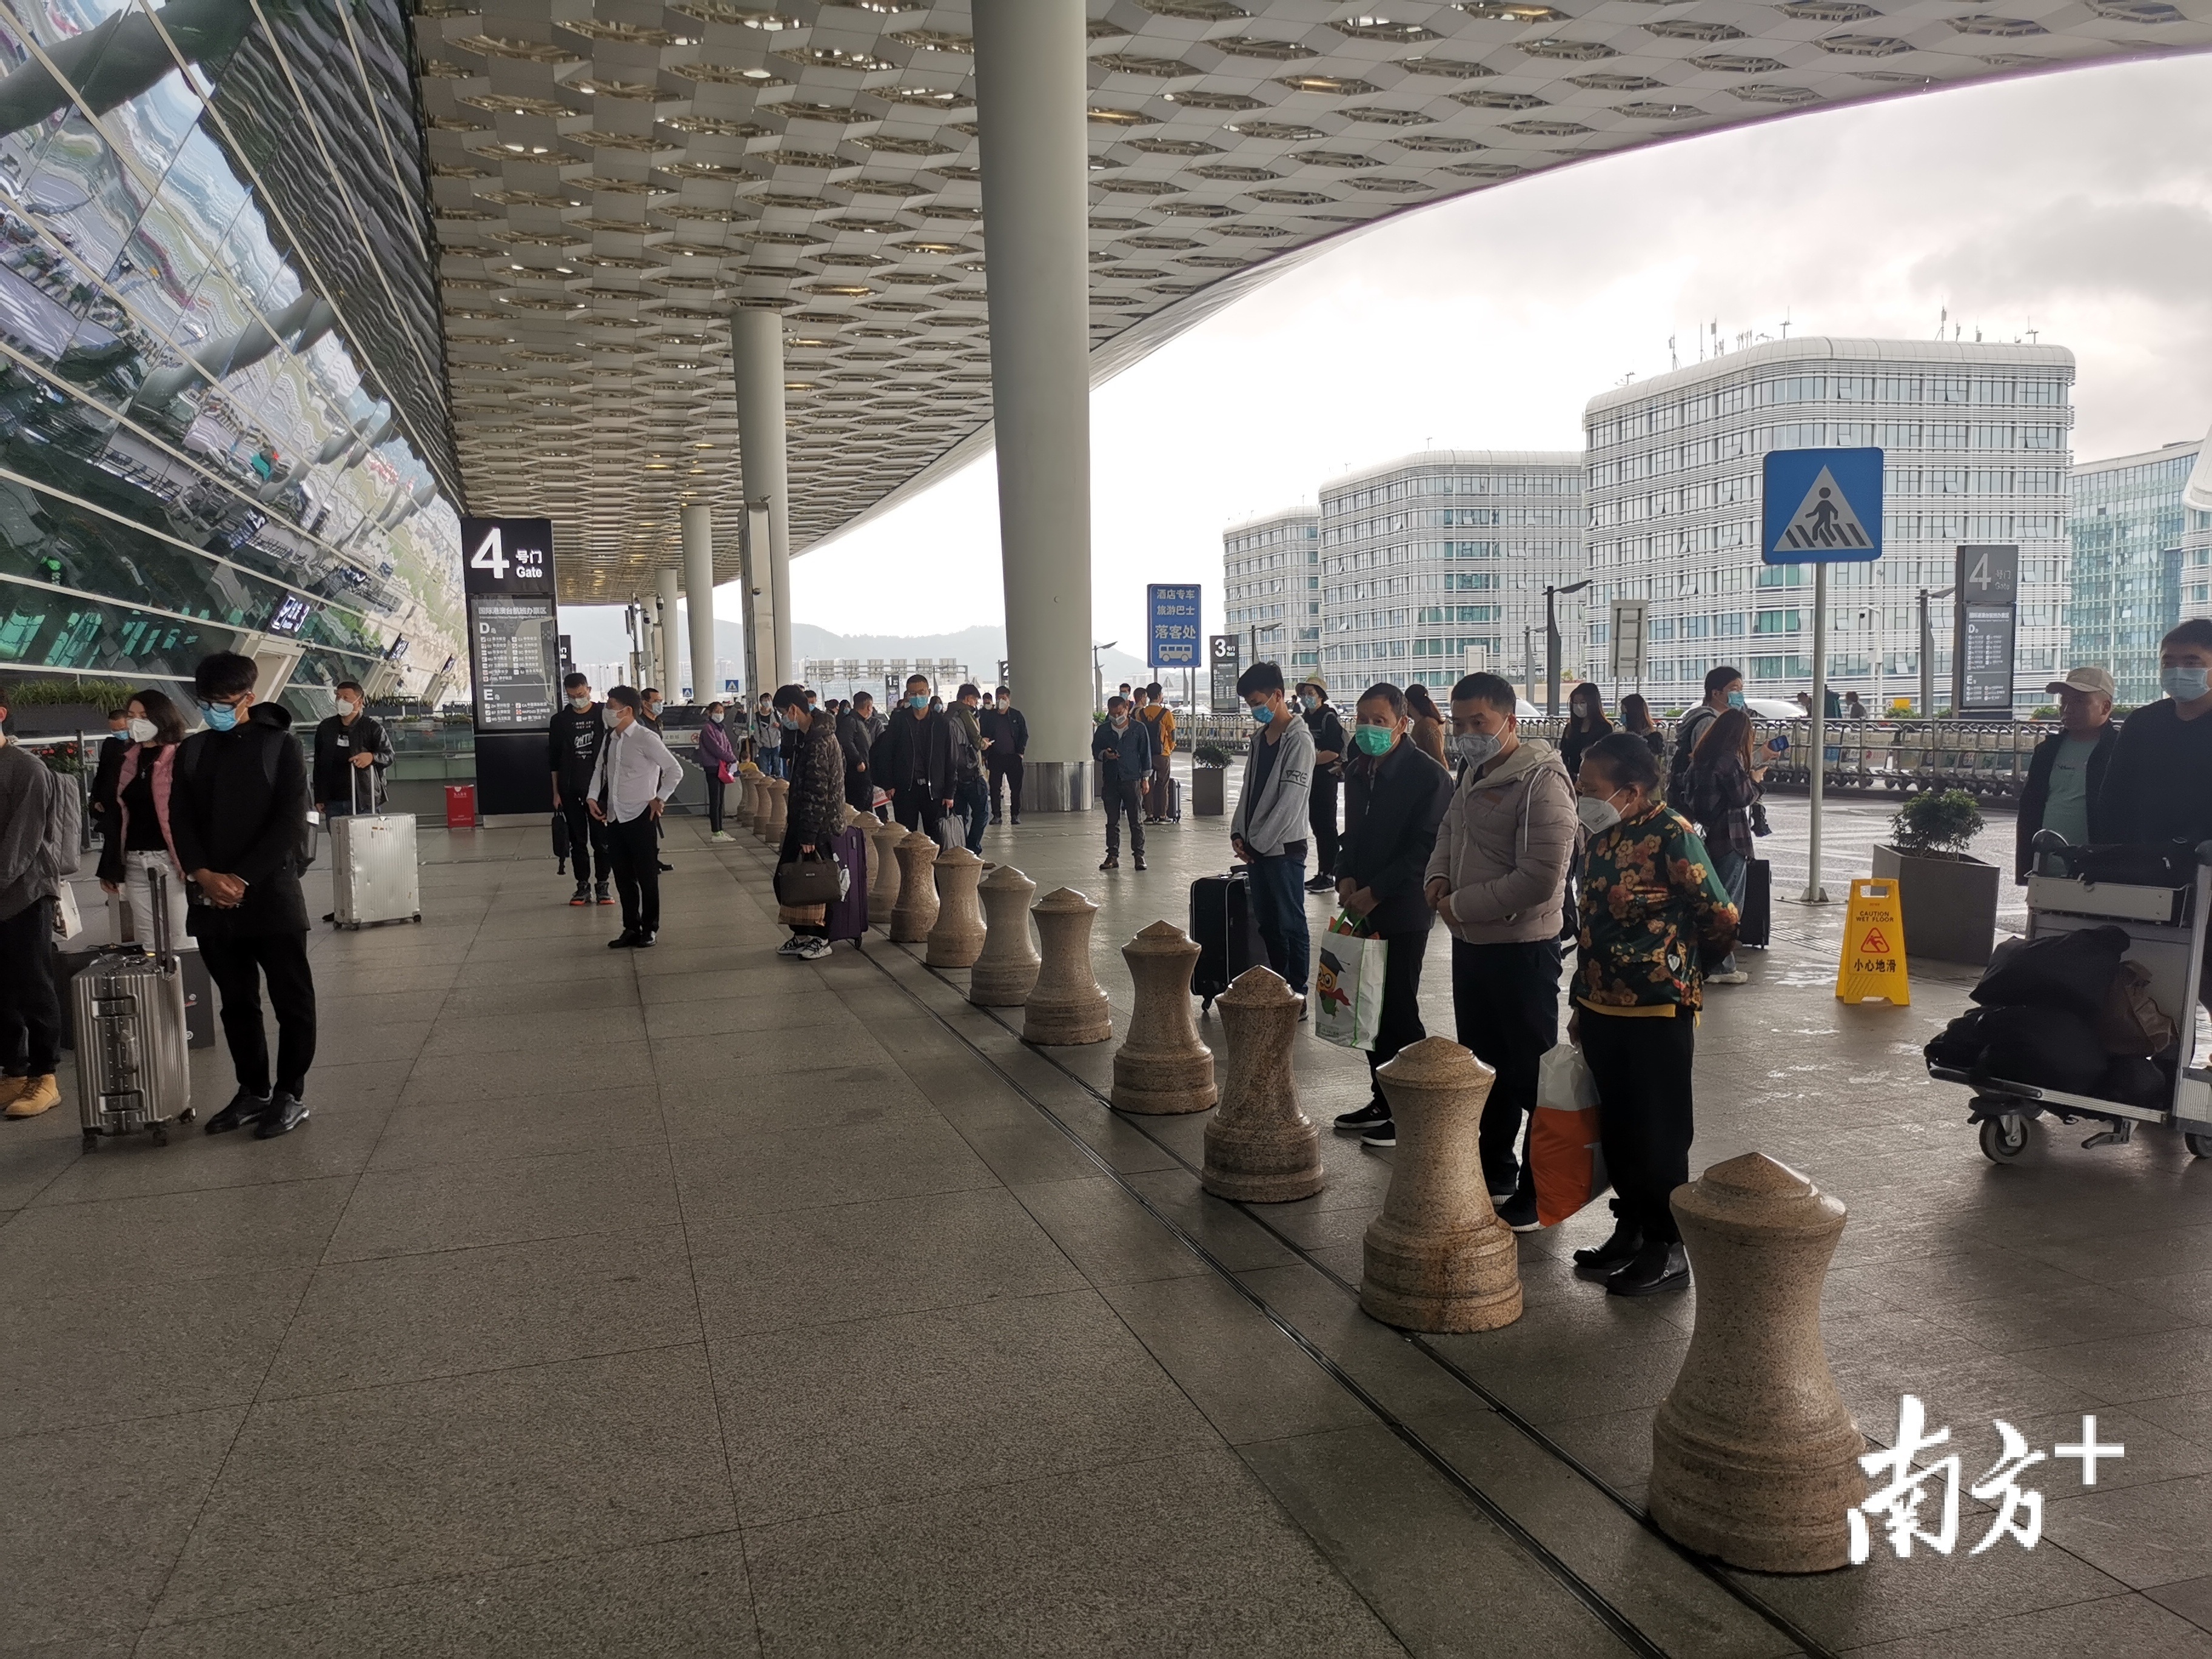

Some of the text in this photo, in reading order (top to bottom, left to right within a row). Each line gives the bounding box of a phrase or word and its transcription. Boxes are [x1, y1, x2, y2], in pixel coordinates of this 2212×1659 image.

[471, 527, 509, 578] 4
[515, 549, 543, 564] 号门
[516, 566, 543, 578] Gate
[1969, 553, 1991, 591] 4
[1995, 569, 2011, 580] 号门
[1157, 589, 1195, 600] 酒店专车
[1157, 605, 1195, 615] 旅游巴士
[479, 623, 490, 634] D
[1155, 625, 1196, 639] 落客处
[1968, 624, 1975, 633] D
[1215, 638, 1225, 657] 3
[888, 676, 892, 686] 1
[1966, 675, 1972, 684] E
[484, 689, 494, 700] E
[1854, 958, 1896, 973] 小心地滑
